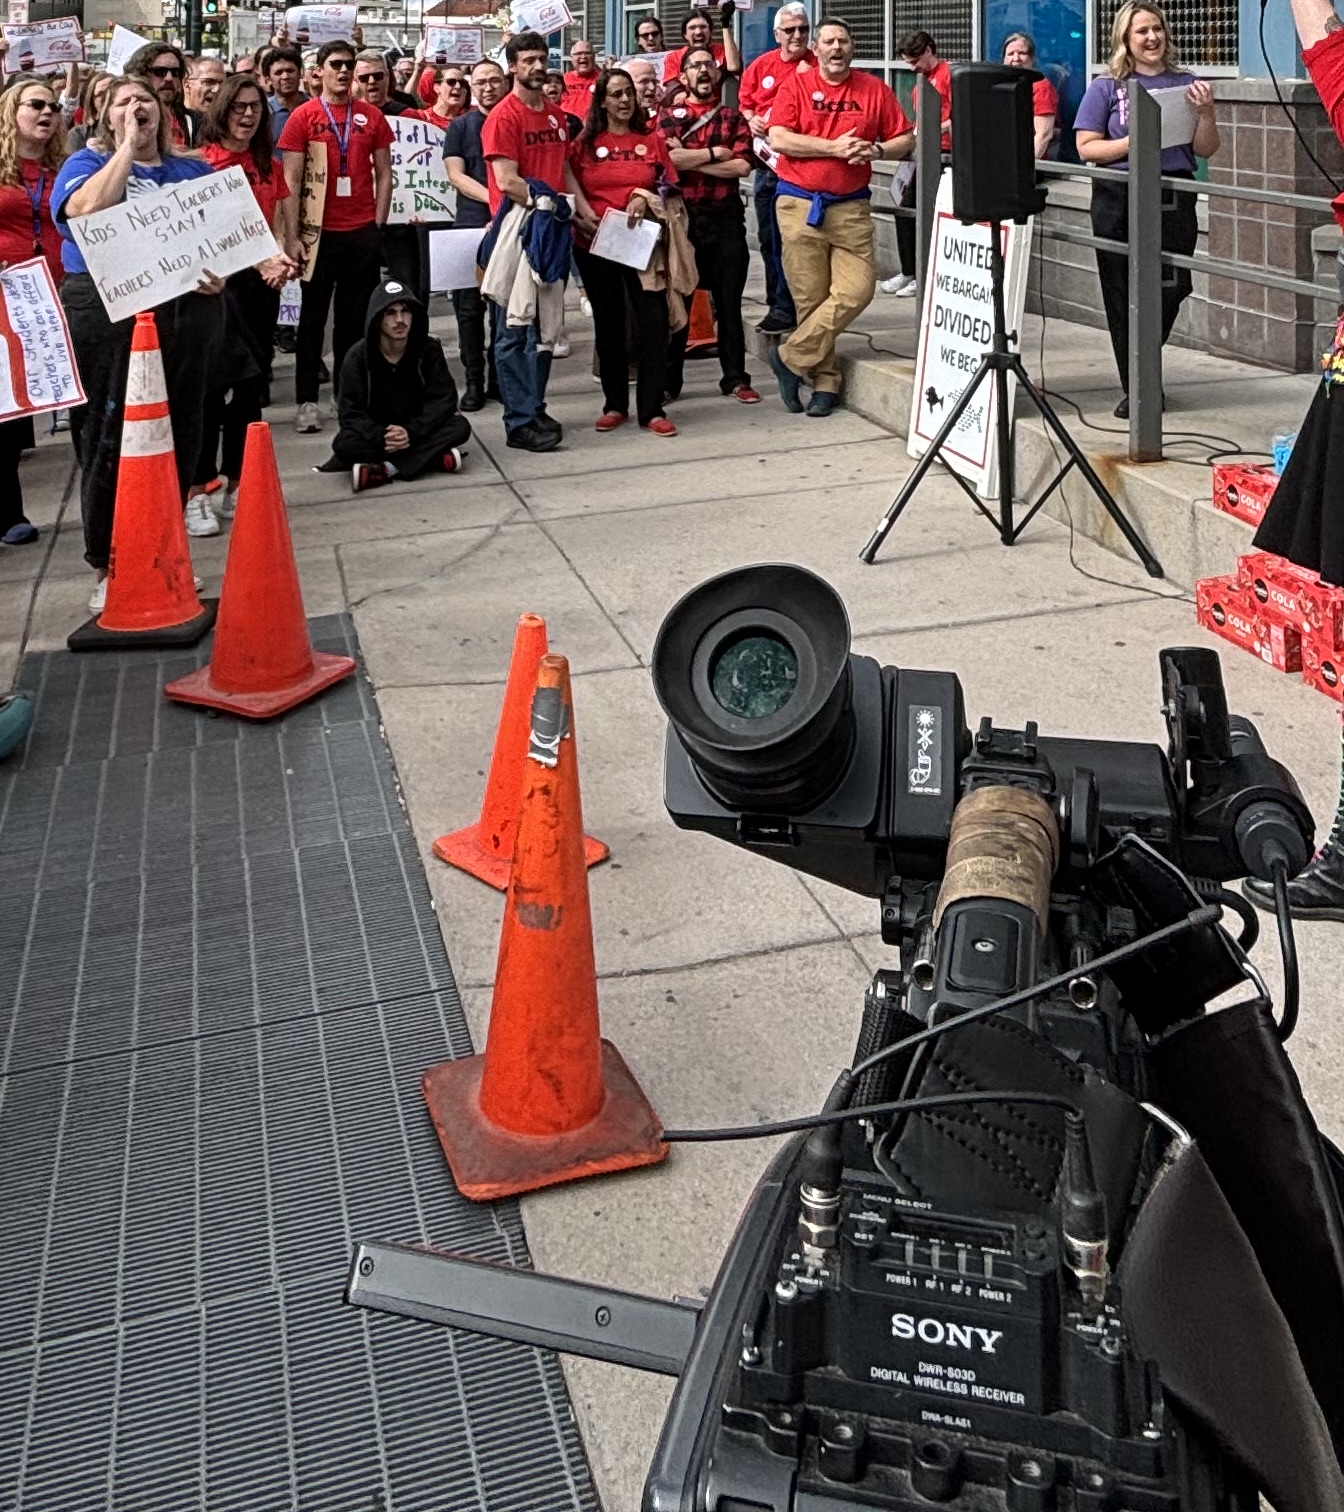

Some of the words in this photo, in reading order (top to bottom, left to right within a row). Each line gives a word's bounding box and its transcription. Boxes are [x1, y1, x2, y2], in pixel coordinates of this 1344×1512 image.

[406, 123, 420, 143] of
[601, 149, 645, 163] CTA
[405, 169, 455, 196] Integr
[392, 198, 404, 214] is
[197, 244, 210, 261] A
[16, 274, 39, 305] afford
[936, 272, 951, 292] WE
[933, 304, 992, 345] DIVIDED
[940, 344, 956, 367] WE
[1240, 493, 1262, 513] COLA
[1270, 590, 1296, 613] COLA
[1227, 613, 1252, 636] COLA
[894, 1197, 934, 1210] SELECT
[885, 1273, 911, 1285] POWER
[925, 1279, 937, 1289] RF
[951, 1283, 963, 1294] RF
[965, 1286, 972, 1296] 2
[978, 1288, 1005, 1302] POWER
[1005, 1291, 1012, 1303] 2
[890, 1312, 1004, 1354] SONY
[918, 1361, 976, 1383] DWR-S03D
[869, 1366, 911, 1384] DIGITAL
[913, 1372, 968, 1396] WIRELESS
[970, 1385, 1025, 1406] RECEIVER
